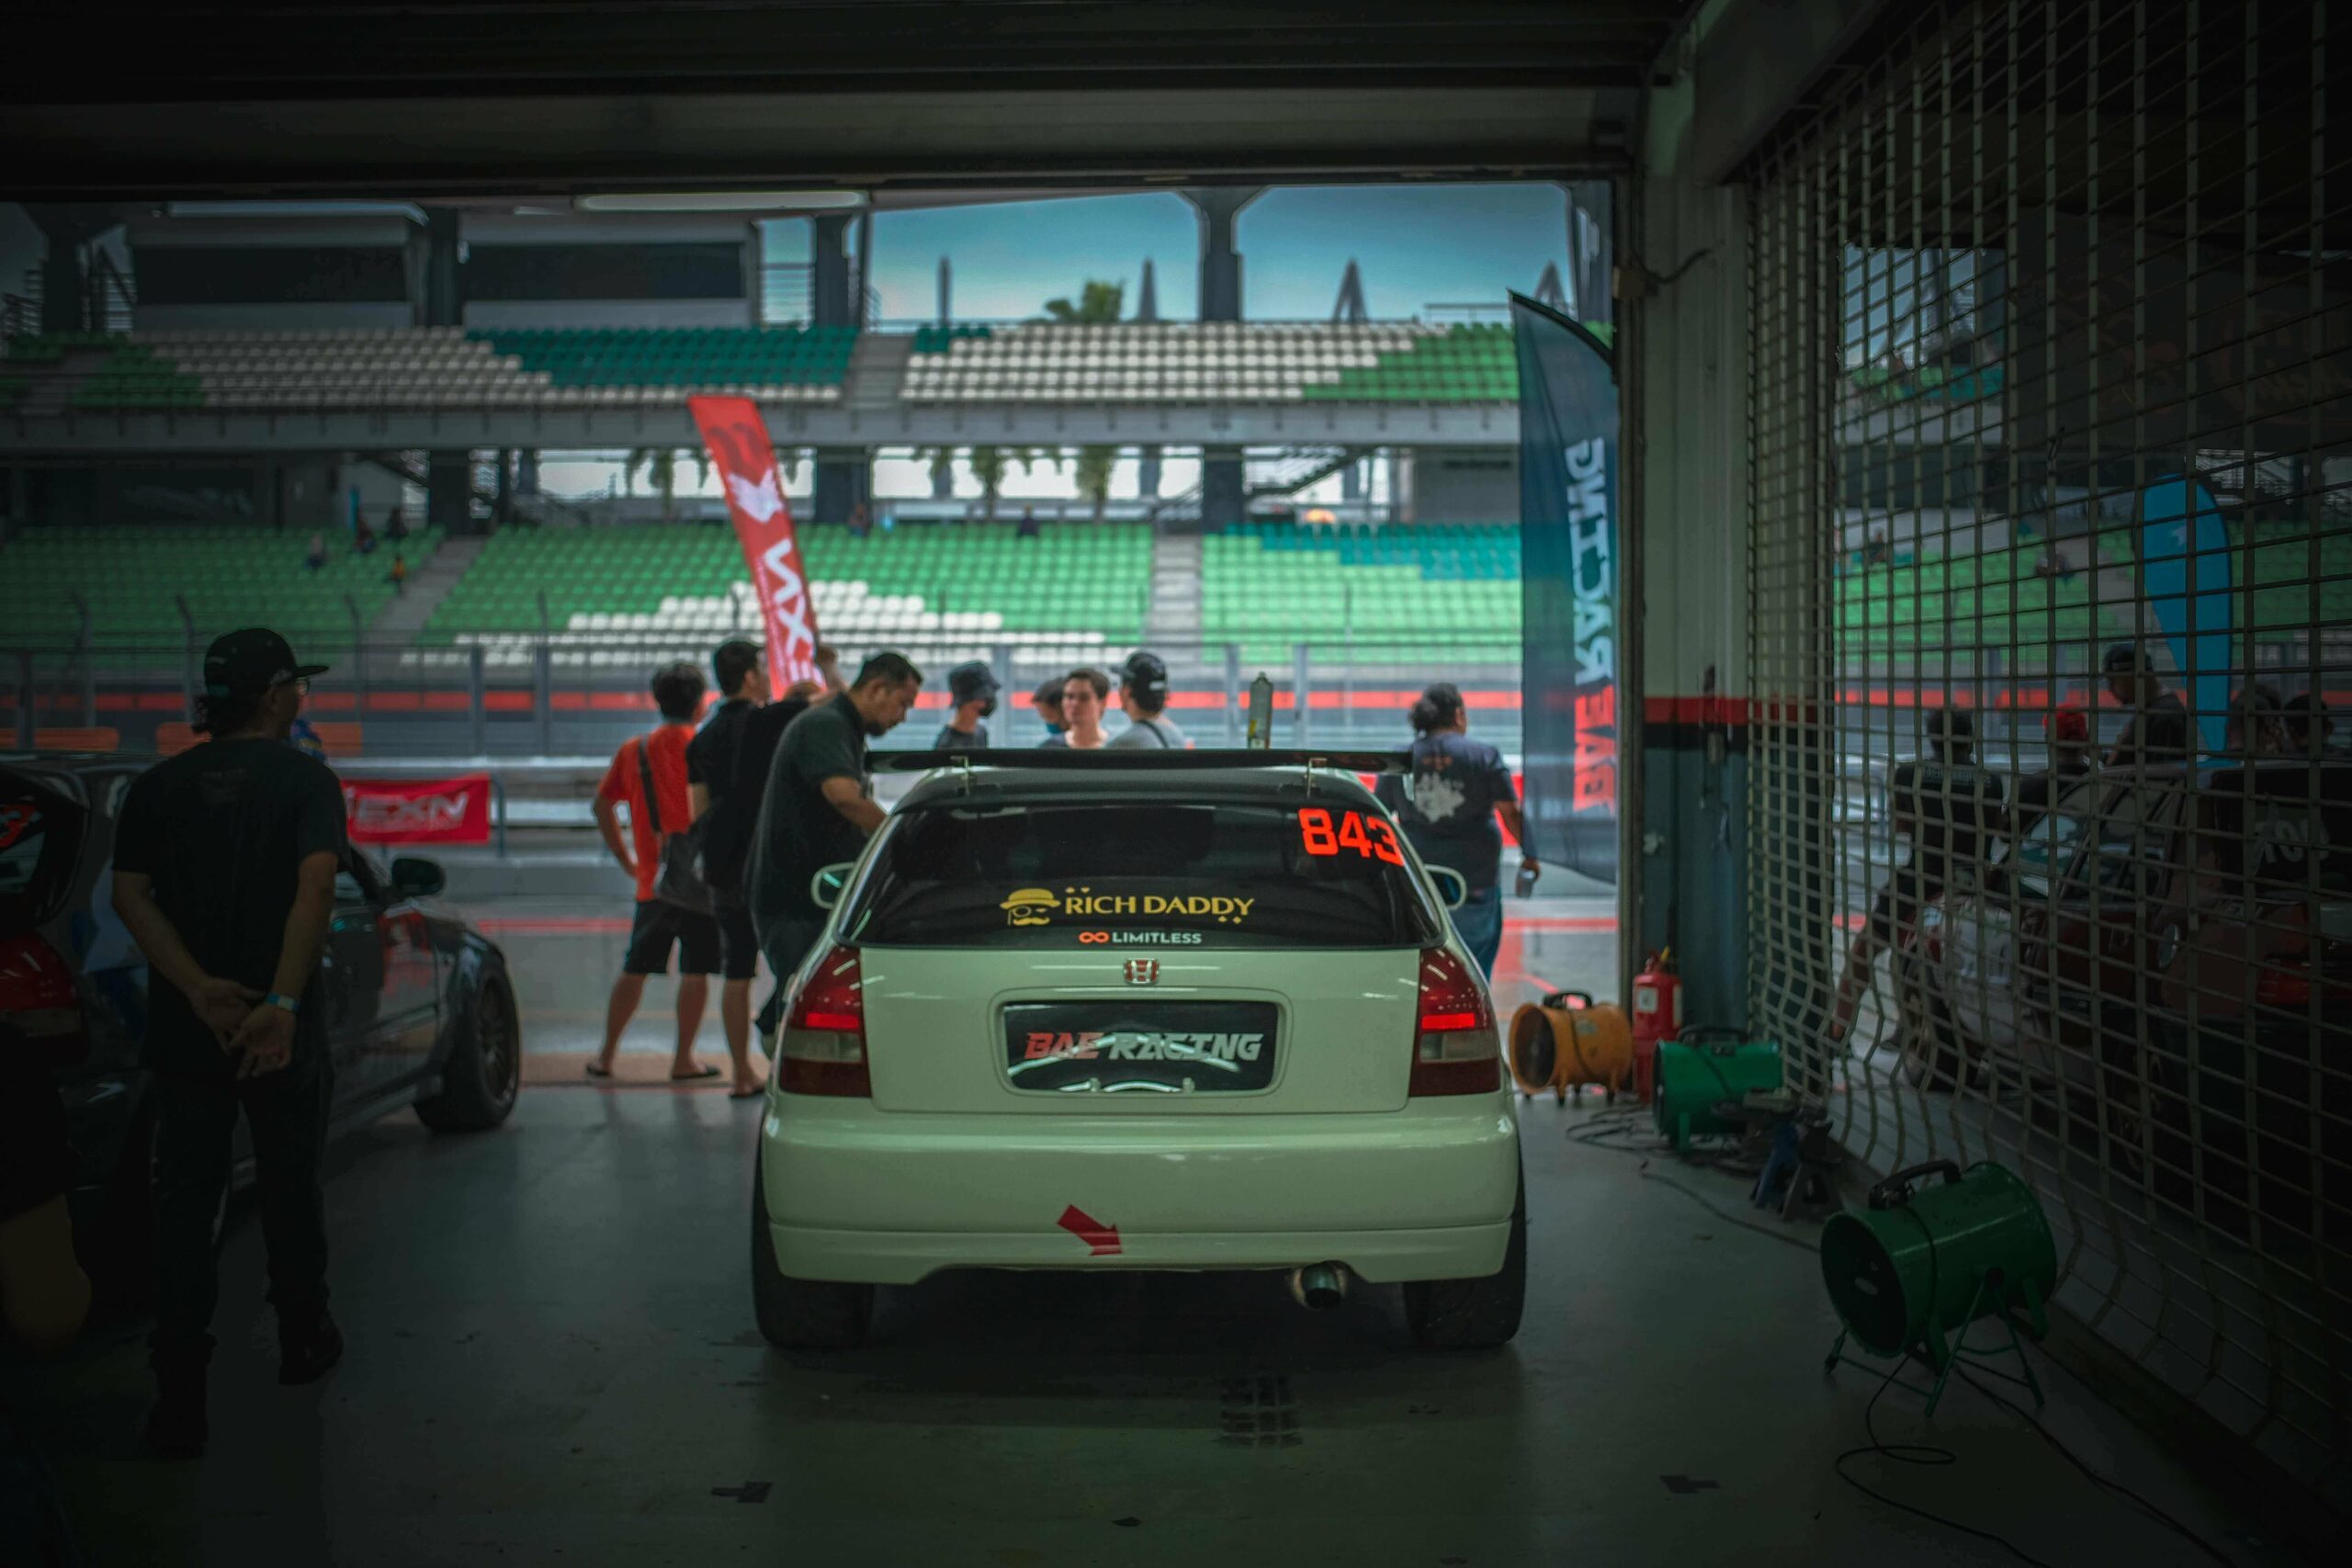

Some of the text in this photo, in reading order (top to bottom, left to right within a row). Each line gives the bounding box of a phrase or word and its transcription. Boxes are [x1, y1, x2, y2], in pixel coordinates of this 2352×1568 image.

[1298, 807, 1406, 866] 843
[1065, 895, 1255, 917] RICH DADDY
[1112, 931, 1203, 944] LIMITLESS
[1024, 1032, 1264, 1062] BAE RACING
